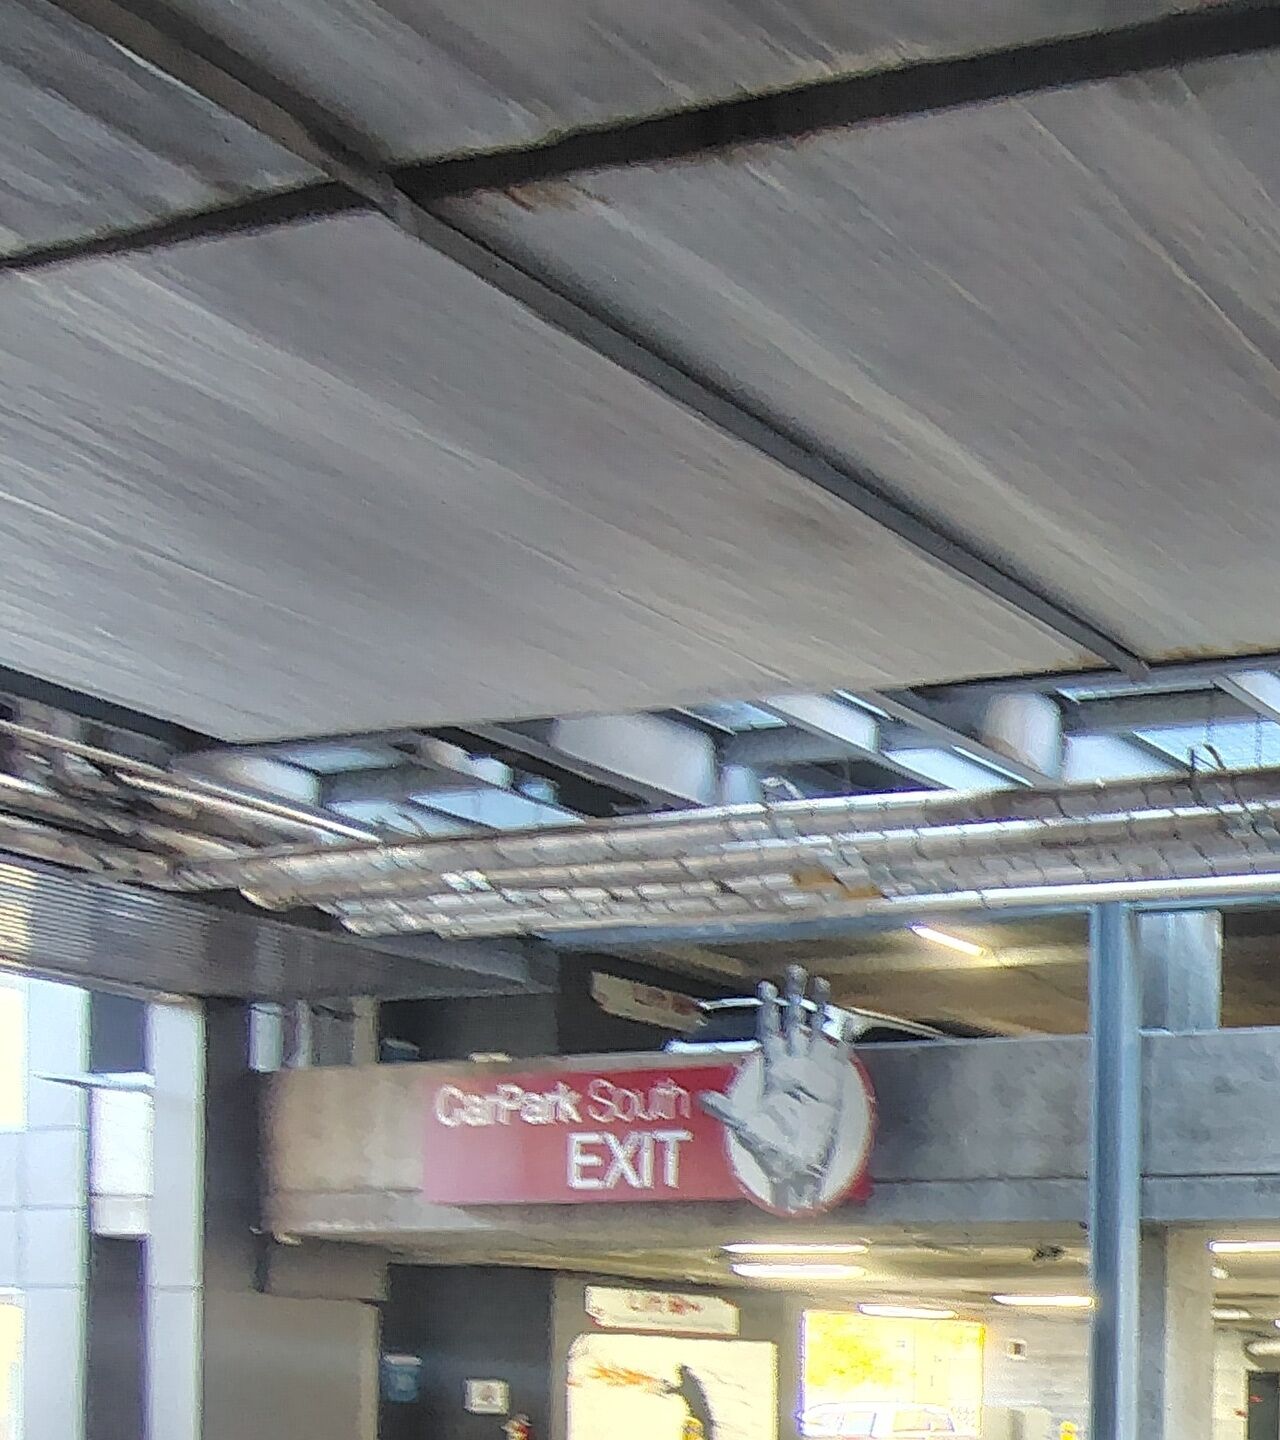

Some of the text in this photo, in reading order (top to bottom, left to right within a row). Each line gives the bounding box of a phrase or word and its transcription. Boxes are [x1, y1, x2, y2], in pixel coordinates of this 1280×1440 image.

[434, 1077, 692, 1127] CarPark South
[566, 1128, 694, 1190] EXIT
